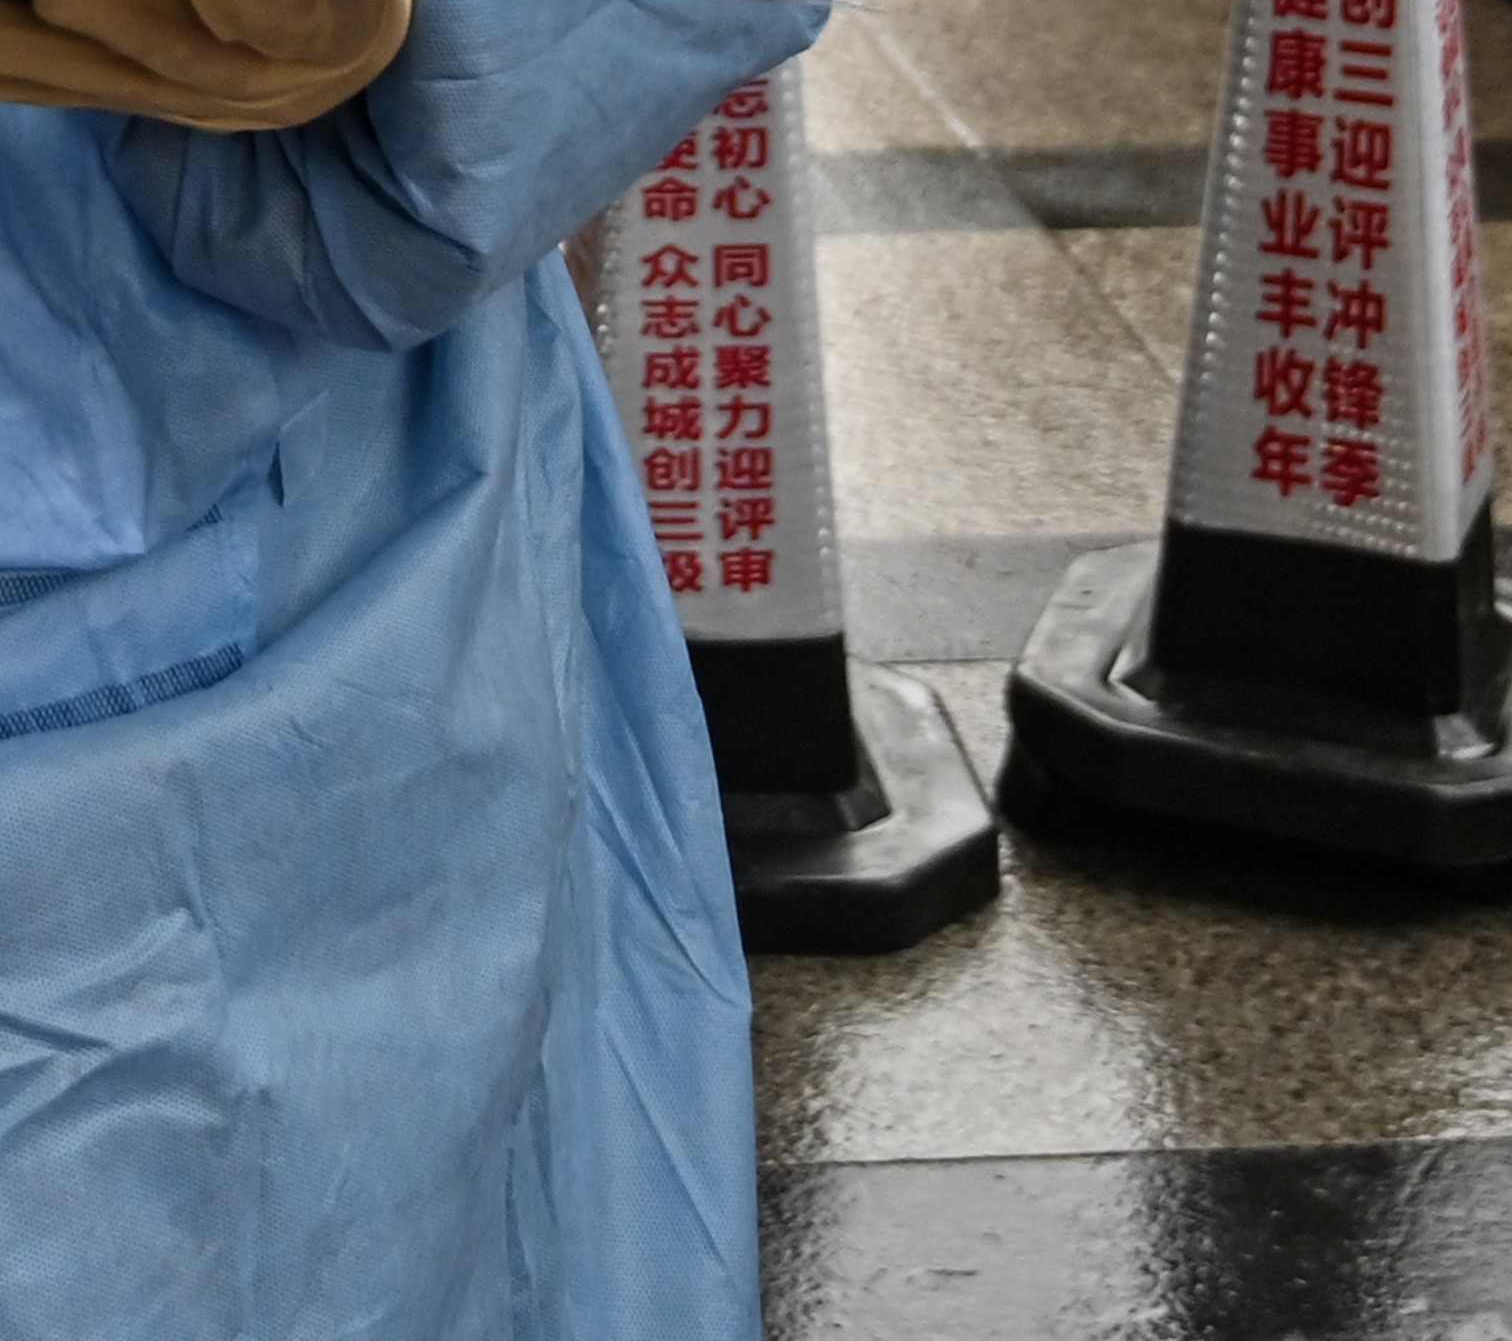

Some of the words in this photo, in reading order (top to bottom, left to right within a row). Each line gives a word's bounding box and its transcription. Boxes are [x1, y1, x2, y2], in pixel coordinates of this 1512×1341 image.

[711, 242, 777, 595] 同心聚力迎评审
